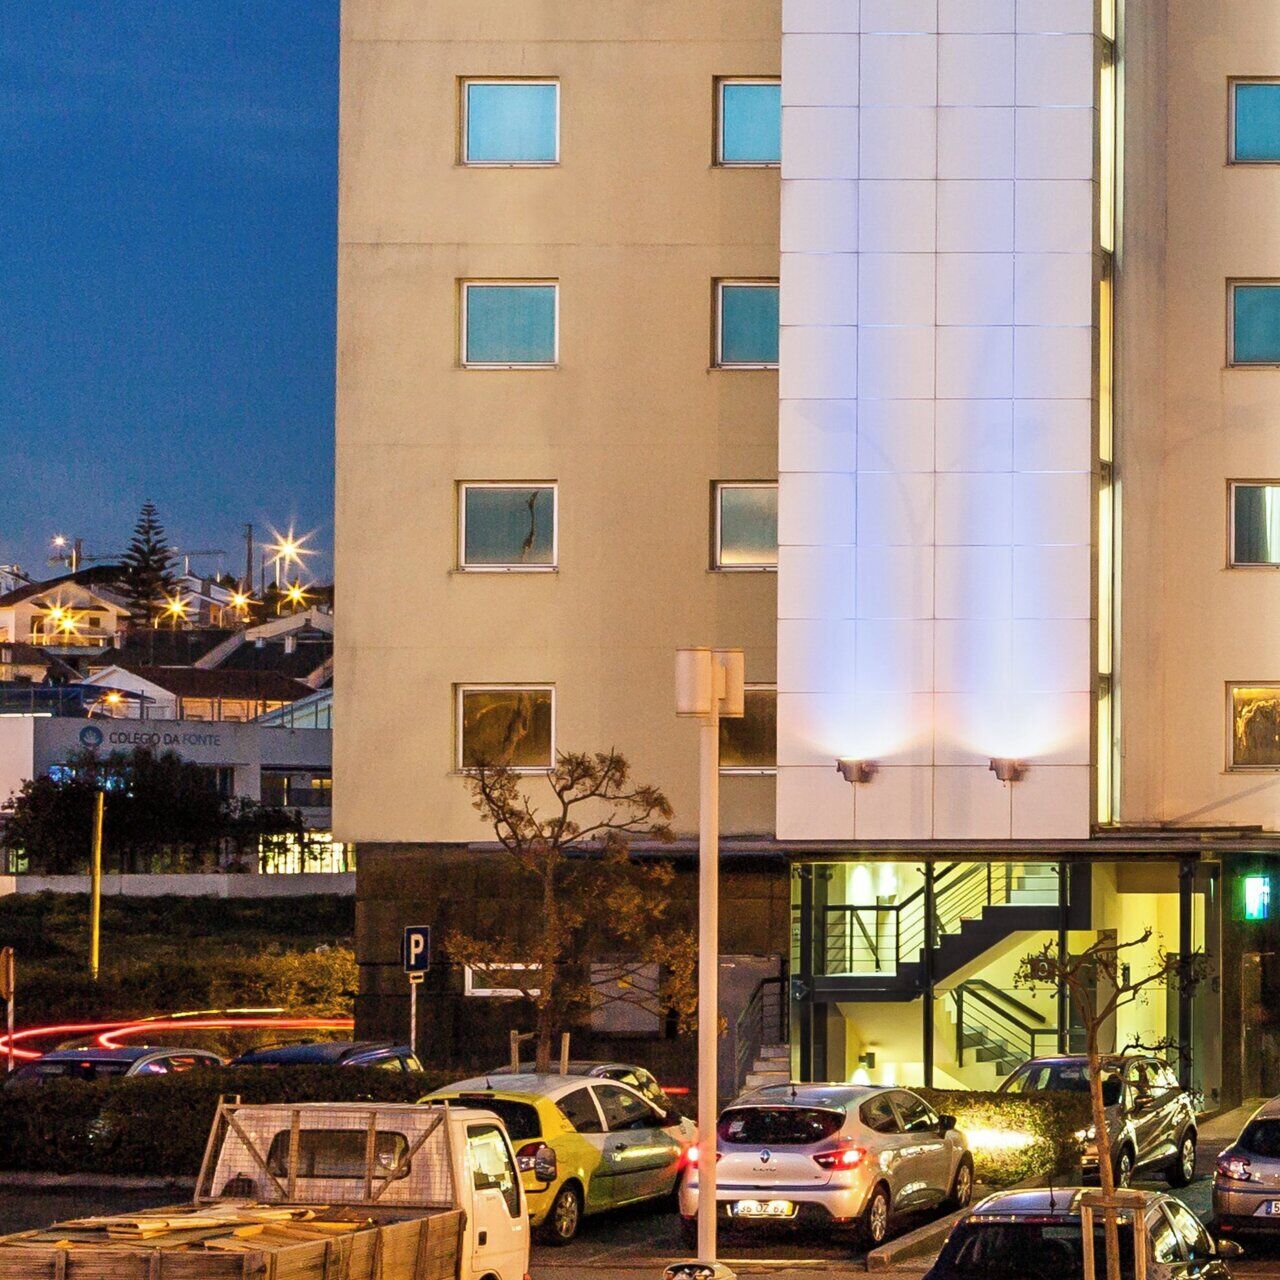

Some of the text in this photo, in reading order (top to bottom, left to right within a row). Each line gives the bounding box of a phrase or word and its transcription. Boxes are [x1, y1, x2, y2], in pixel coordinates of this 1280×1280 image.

[164, 732, 180, 745] DA
[182, 733, 221, 747] FONTE
[410, 933, 425, 965] P
